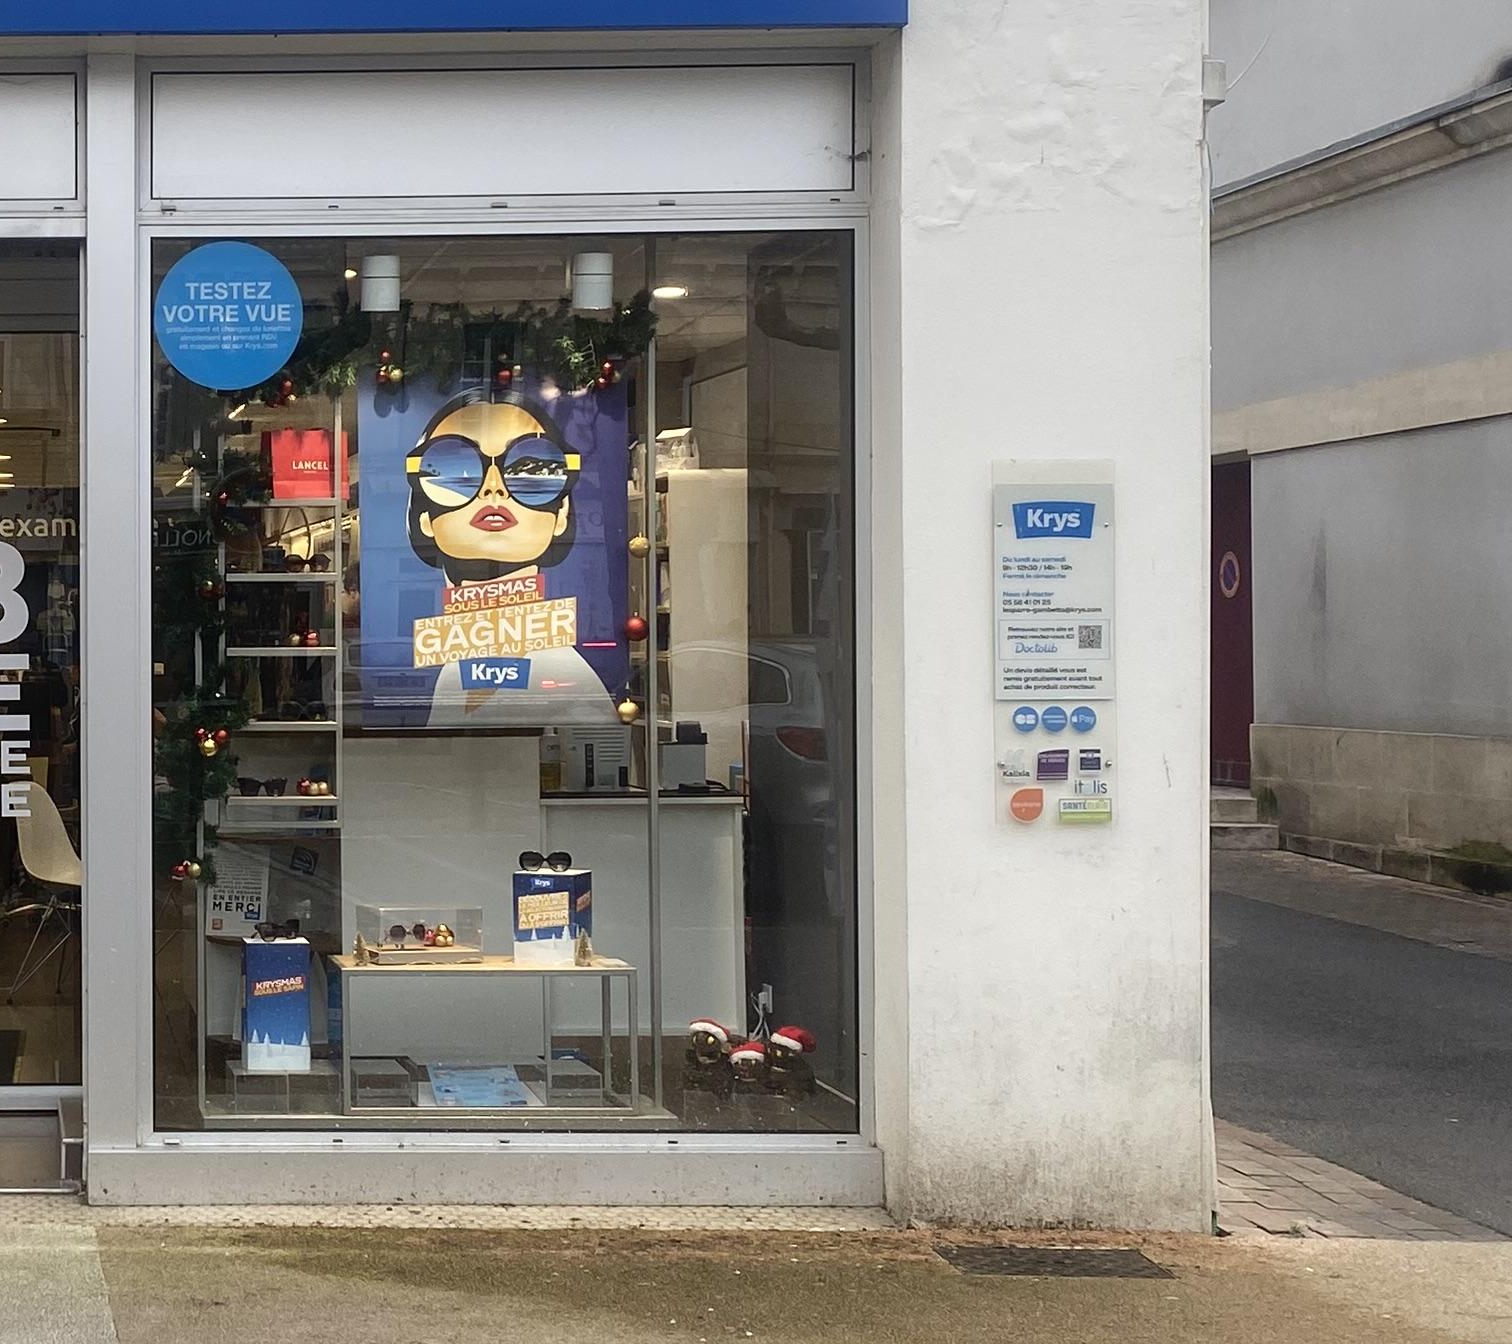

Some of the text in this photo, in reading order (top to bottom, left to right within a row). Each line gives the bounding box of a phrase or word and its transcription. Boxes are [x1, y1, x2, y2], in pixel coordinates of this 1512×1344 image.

[185, 282, 272, 300] TESTEZ
[162, 304, 291, 323] VOTRE VUE
[292, 460, 329, 471] LANCEL
[1027, 509, 1081, 532] Krys
[451, 577, 537, 604] KRYSMAS
[444, 591, 544, 614] SOUS LE SOLEIL
[415, 598, 575, 630] ENTREZ ET TENTEZ DE
[415, 608, 576, 655] GAGNER
[415, 634, 576, 666] UN VOYAGE AU SOLEIL
[1015, 642, 1058, 654] Doctolib
[471, 663, 519, 684] Krys
[213, 901, 261, 913] MERCI
[255, 976, 302, 989] KRYSMAS
